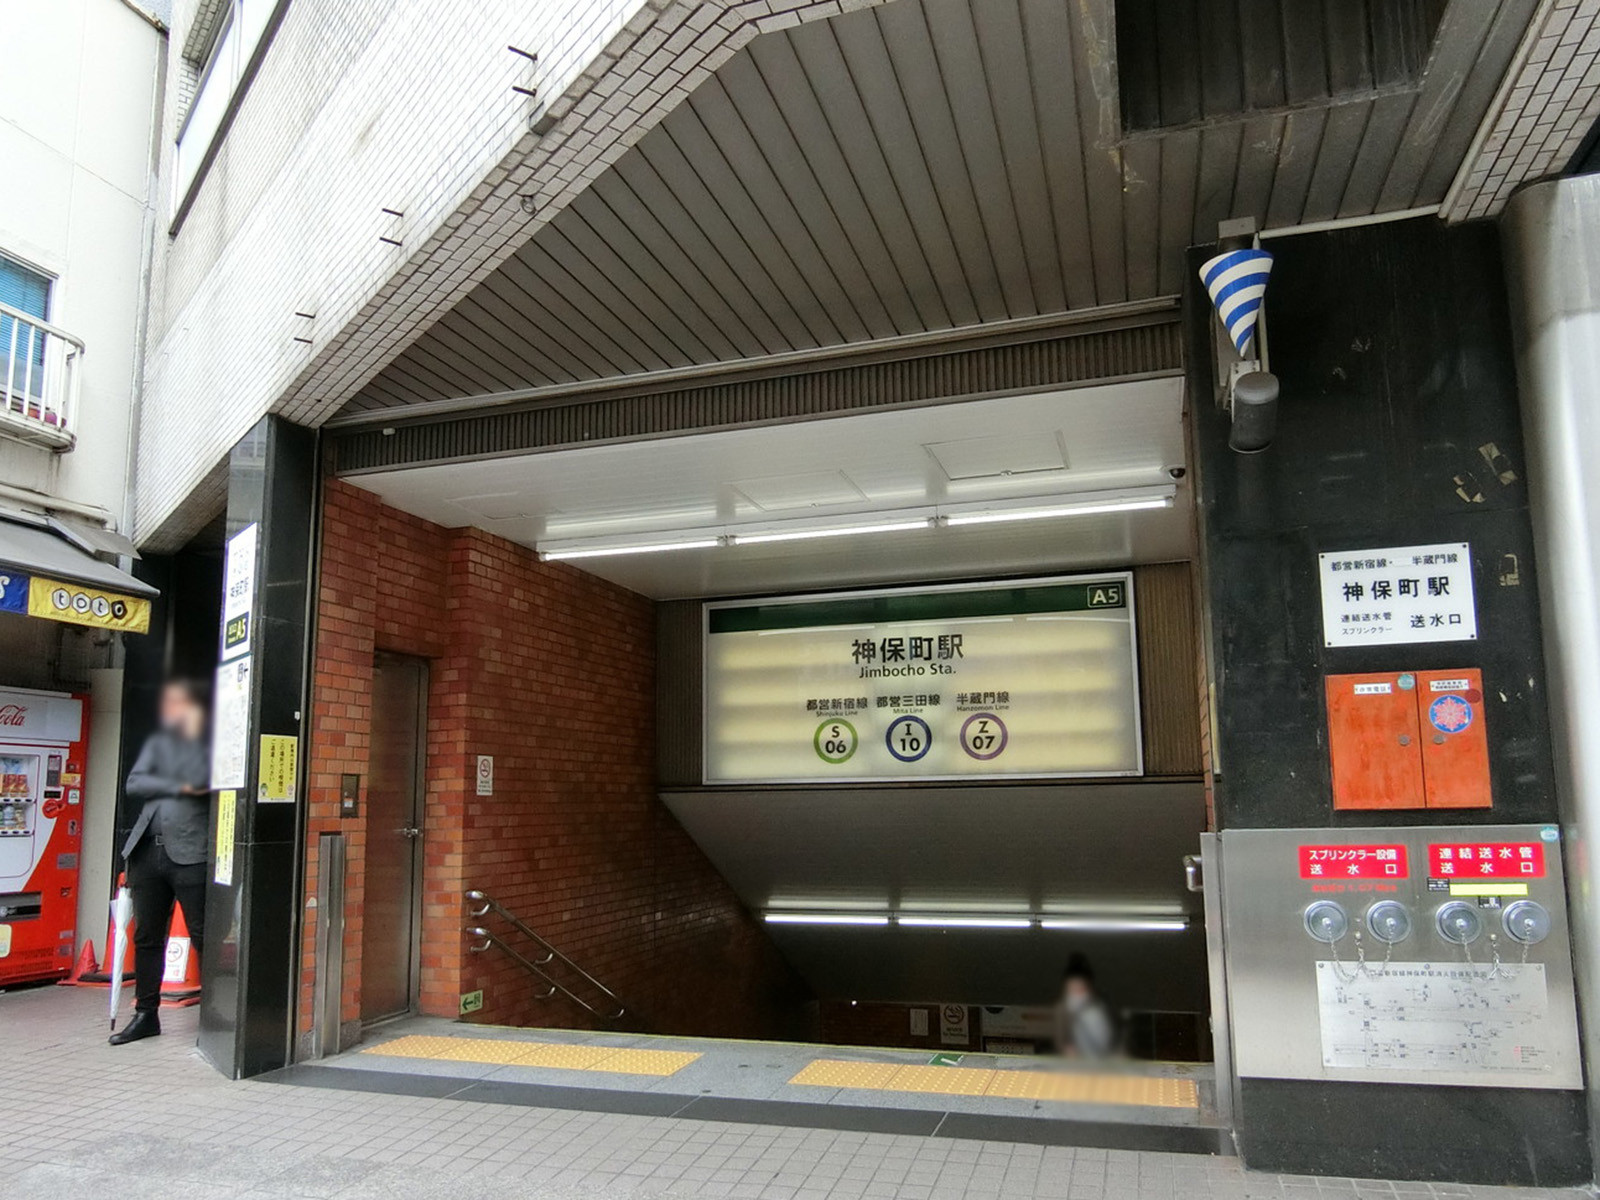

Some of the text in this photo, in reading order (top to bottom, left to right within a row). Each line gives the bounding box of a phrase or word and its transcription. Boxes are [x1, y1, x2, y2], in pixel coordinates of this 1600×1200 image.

[1412, 553, 1458, 565] 半蔵門線
[1342, 576, 1450, 601] 神保町駅
[1092, 588, 1119, 604] A5
[55, 590, 125, 617] toto
[1341, 612, 1392, 623] 連結送水管
[1410, 613, 1462, 628] 送水口
[1342, 627, 1393, 636] スプリンクラー
[851, 634, 965, 664] 神保町駅
[859, 663, 957, 678] Jimbocho Sta.
[806, 697, 868, 711] 都営新宿線
[876, 694, 941, 708] 都営三田線
[956, 691, 1010, 704] 半蔵門線
[831, 726, 841, 738] S
[905, 724, 912, 736] I
[978, 721, 989, 733] Z
[825, 740, 847, 754] 06
[900, 738, 920, 752] 10
[972, 736, 995, 750] 07
[1309, 849, 1397, 860] スプリンクラー設備
[1439, 847, 1533, 859] 連結送水管
[1310, 864, 1398, 875] 送水口
[1441, 862, 1533, 874] 送水口
